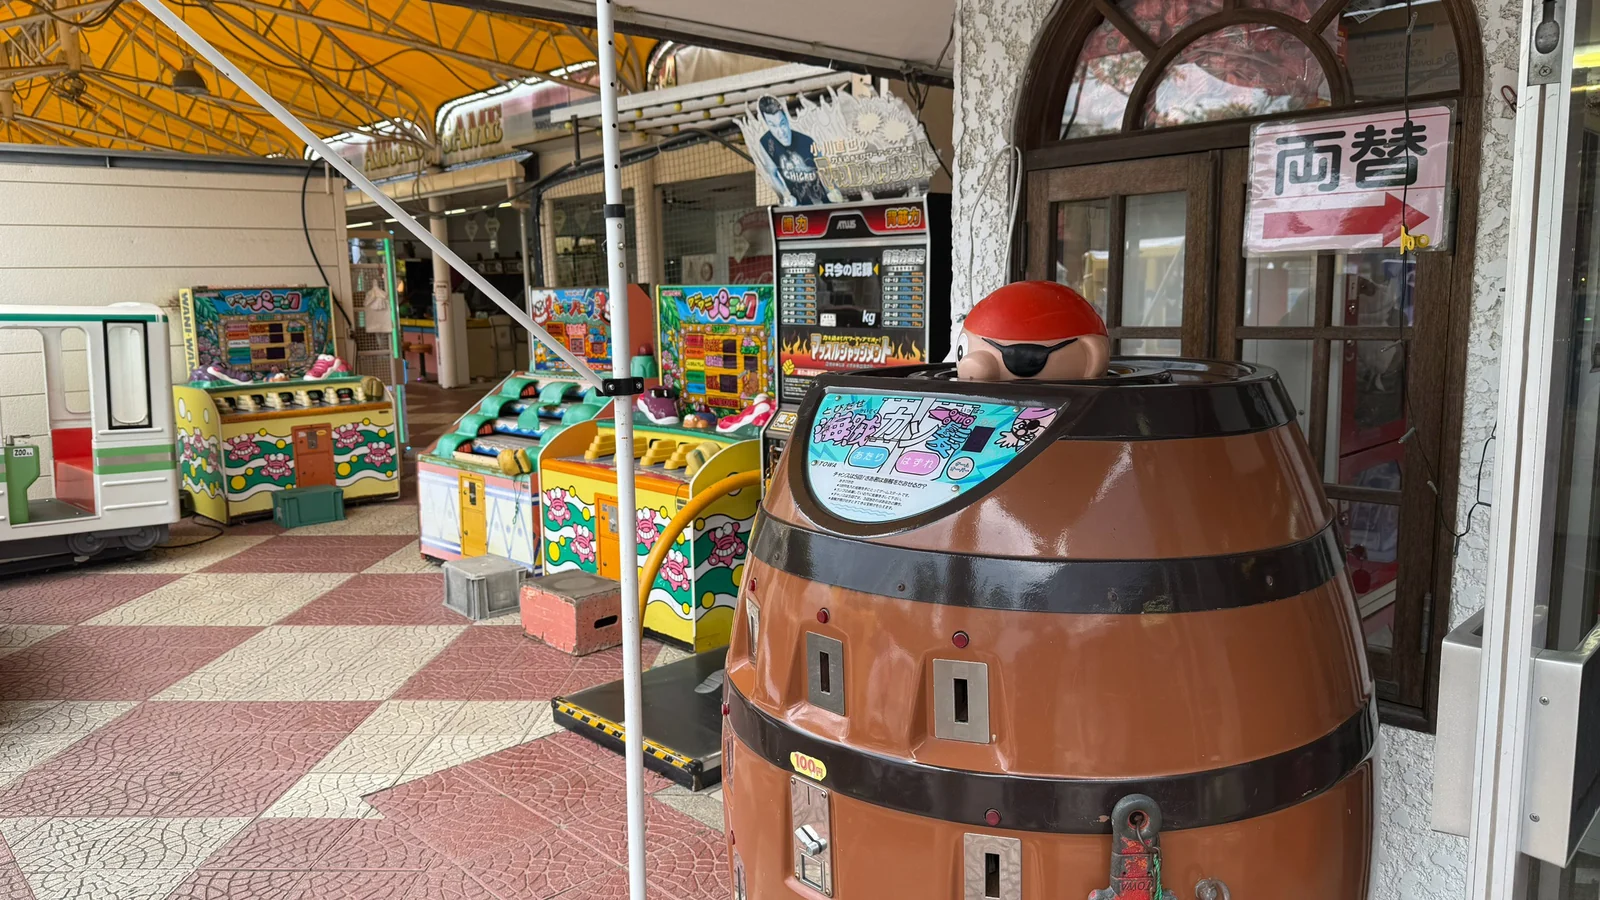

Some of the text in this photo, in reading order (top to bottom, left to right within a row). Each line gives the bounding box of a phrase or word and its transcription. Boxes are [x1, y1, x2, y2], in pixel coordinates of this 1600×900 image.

[1275, 120, 1427, 195] 両替
[885, 207, 921, 228] 背筋力
[824, 262, 873, 277] 只今の記録
[862, 310, 876, 325] kg
[810, 333, 892, 364] マッスルジャッジメント
[823, 399, 866, 415] とびだせ
[853, 451, 885, 463] あたり
[899, 455, 935, 470] はずれ
[1121, 880, 1151, 891] TOWA
